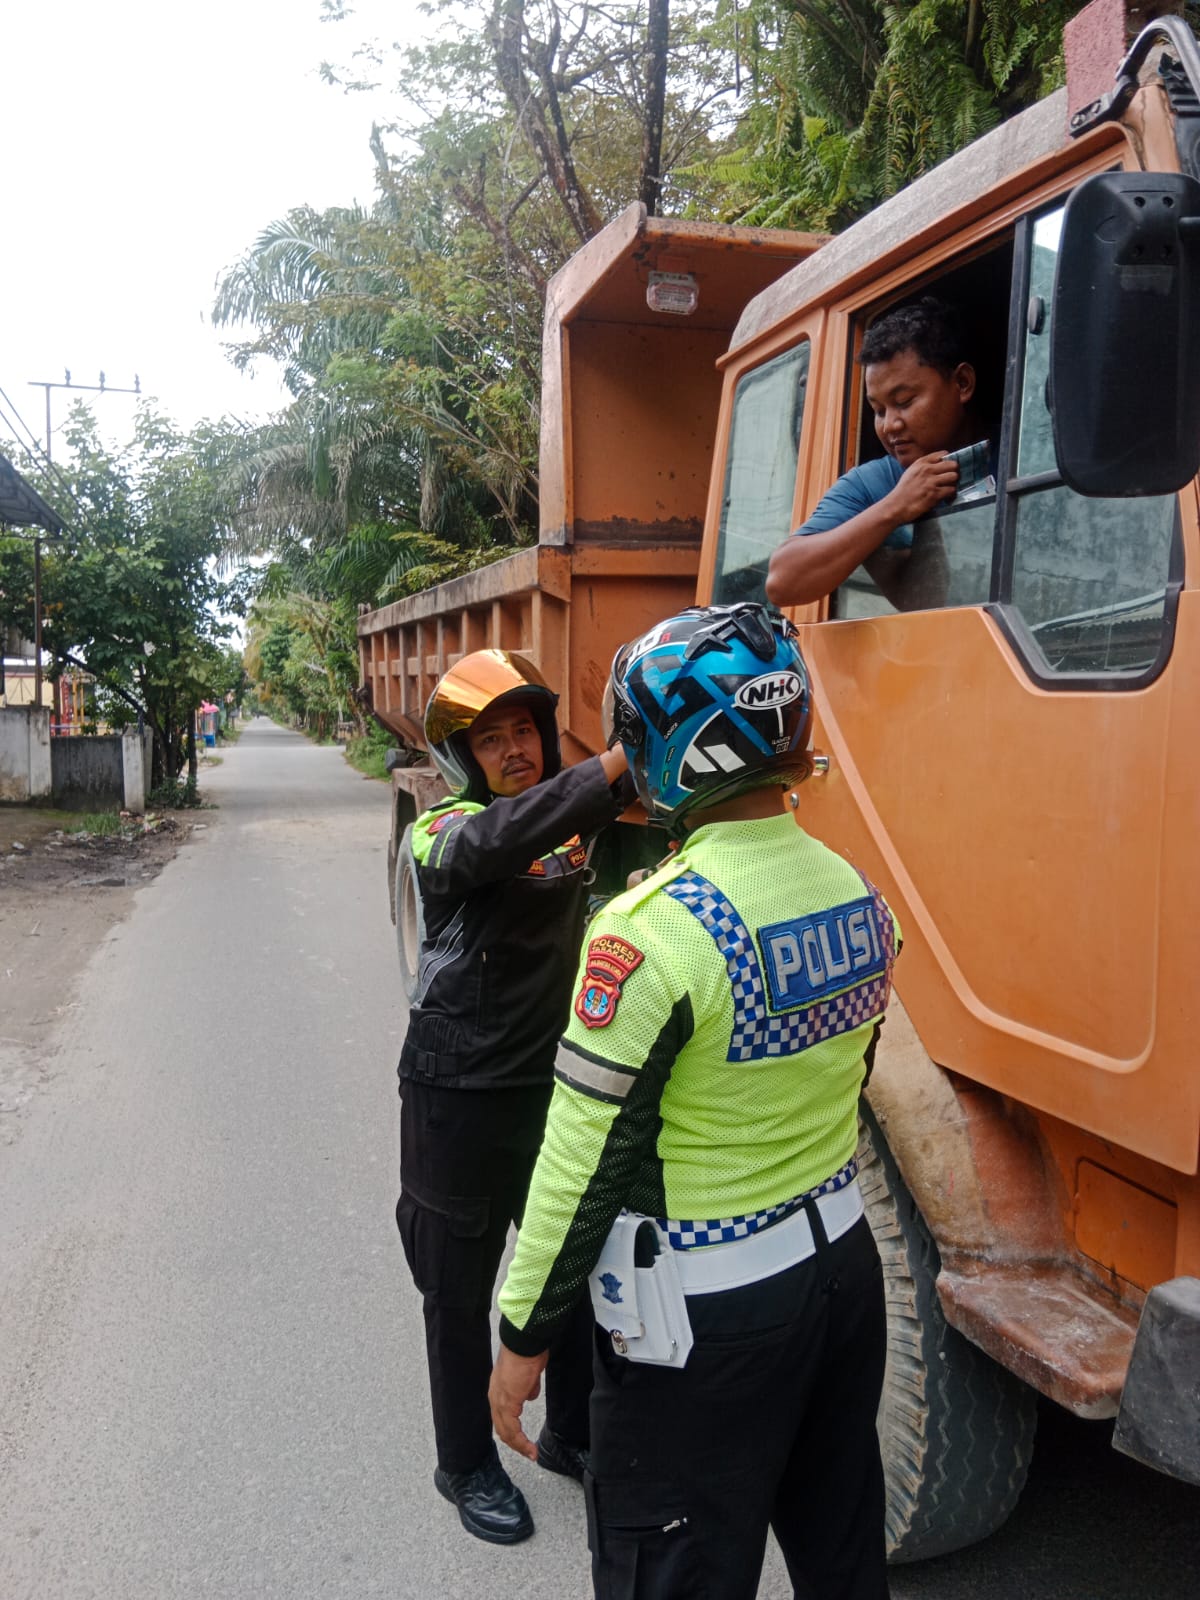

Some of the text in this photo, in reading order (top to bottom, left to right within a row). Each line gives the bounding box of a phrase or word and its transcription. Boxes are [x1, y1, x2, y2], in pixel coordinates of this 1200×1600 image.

[747, 677, 794, 705] NHK
[592, 938, 636, 961] POLRES
[768, 906, 881, 997] POLISI
